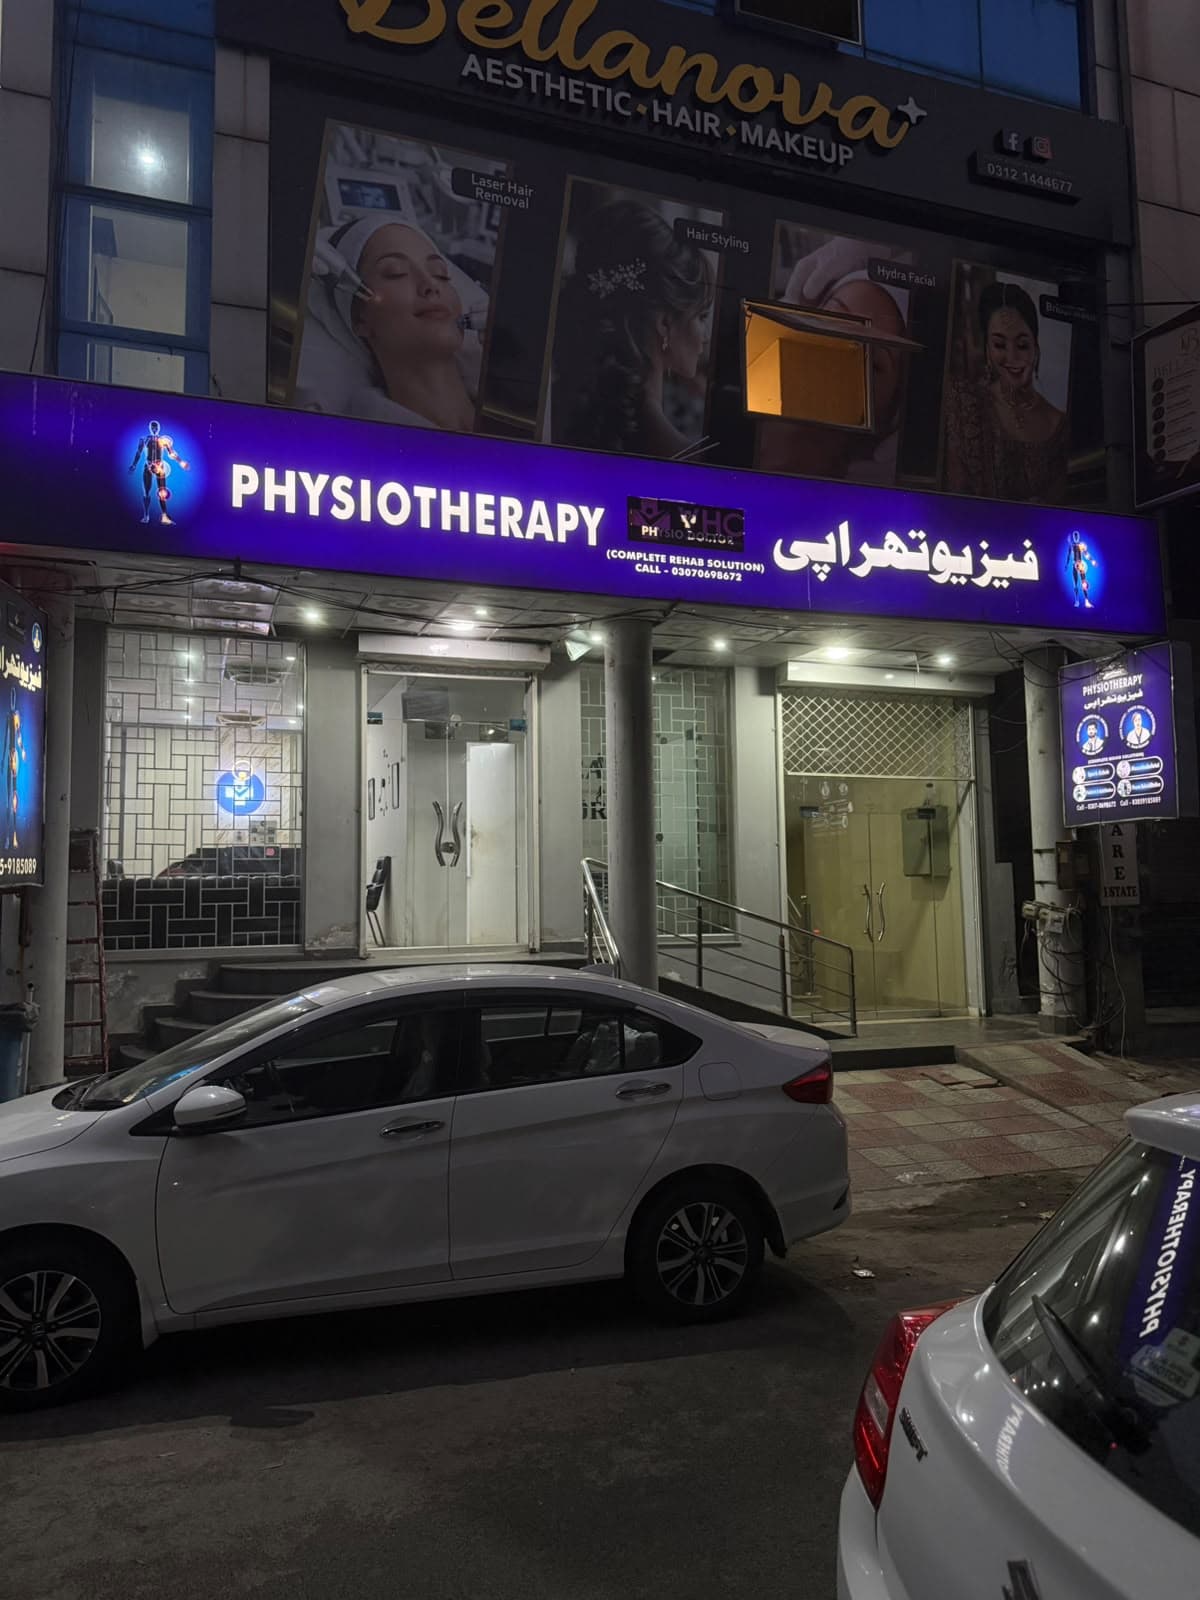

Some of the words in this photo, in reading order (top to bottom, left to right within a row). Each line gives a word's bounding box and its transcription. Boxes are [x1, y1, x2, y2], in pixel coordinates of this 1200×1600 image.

[461, 53, 632, 117] AESTHETIC
[653, 99, 721, 139] HAIR
[741, 120, 854, 167] MAKEUP
[471, 173, 505, 190] Laser
[508, 181, 535, 197] Hair
[987, 163, 1018, 180] 0312
[1022, 172, 1073, 193] 1444677
[475, 187, 530, 209] Removal
[687, 227, 709, 242] Hair
[711, 231, 750, 253] Styling
[877, 265, 906, 282] Hydra
[909, 271, 936, 288] Facial
[232, 463, 605, 546] PHYSIOTHERAPY
[606, 549, 667, 563] (COMPLETE
[669, 556, 705, 567] REHAB
[707, 558, 765, 574] SOLUTION)
[635, 563, 661, 574] CALL
[671, 567, 742, 582] 03070698672
[1082, 674, 1143, 697] PHYSIOTHERAPY
